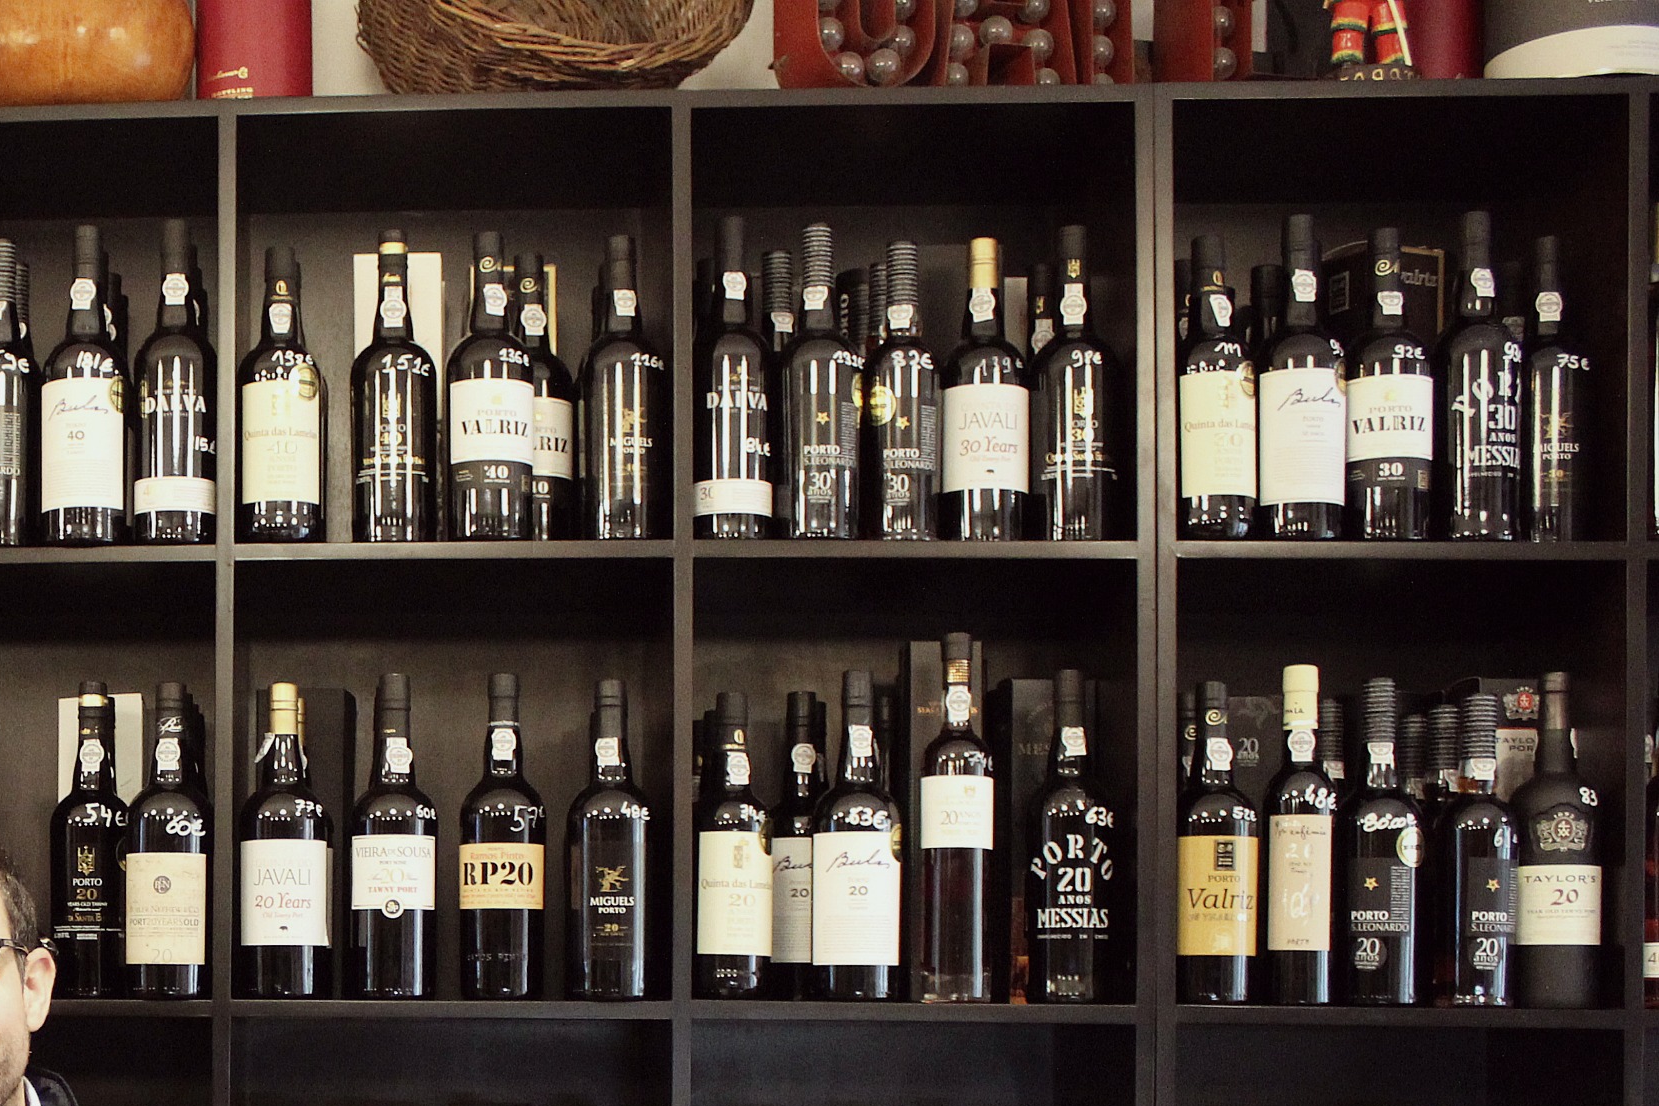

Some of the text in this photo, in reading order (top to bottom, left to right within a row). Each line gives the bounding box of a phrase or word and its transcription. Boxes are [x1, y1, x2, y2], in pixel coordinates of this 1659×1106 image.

[476, 408, 517, 418] PORTO
[958, 411, 1018, 432] JAVALI
[461, 419, 530, 439] VALRIZ
[1352, 414, 1427, 435] VALRIZ
[67, 430, 85, 441] 40
[804, 445, 840, 457] PORTO
[960, 436, 1019, 457] 30 Years
[1378, 462, 1404, 478] 30
[809, 471, 831, 490] 30
[886, 473, 909, 494] 30
[355, 846, 388, 859] VIEIRA
[396, 845, 432, 859] SOUSA
[470, 851, 525, 861] Ramos Pinto
[1031, 834, 1113, 881] PORTO
[254, 868, 311, 887] JAVALI
[463, 861, 534, 887] RP20
[1056, 867, 1092, 892] 20
[1523, 875, 1597, 885] TAYLOR'S
[254, 892, 311, 910] 20 Years
[590, 896, 635, 907] MIGUELS
[1187, 886, 1255, 909] Valriz
[1551, 888, 1579, 907] 20
[1036, 908, 1109, 929] MESSIAS
[1472, 911, 1508, 922] PORTO
[1356, 938, 1379, 956] 20
[1475, 938, 1498, 956] 20
